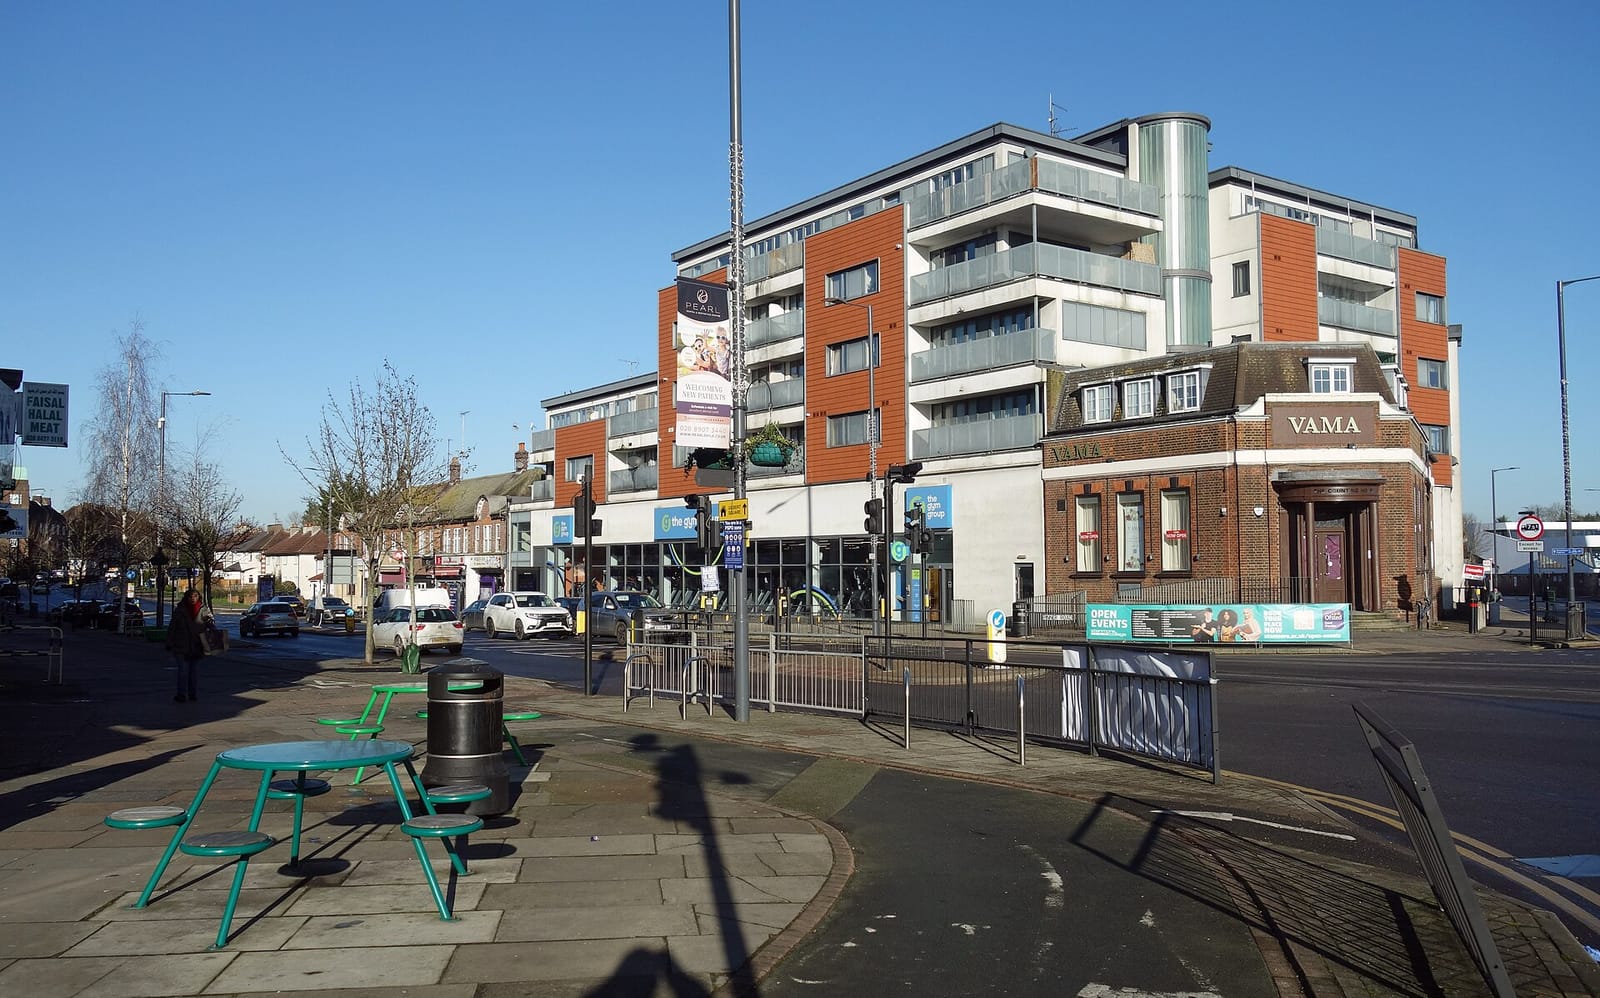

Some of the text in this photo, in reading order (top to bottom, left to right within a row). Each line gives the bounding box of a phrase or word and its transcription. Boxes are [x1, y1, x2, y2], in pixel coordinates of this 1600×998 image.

[686, 302, 720, 314] PEARL
[685, 384, 722, 393] WELCOMING
[698, 392, 726, 400] PATIENTS
[27, 396, 64, 408] FAISAL
[28, 408, 63, 420] HALAL
[31, 422, 60, 433] MEAT
[1287, 416, 1361, 434] VAMA
[1053, 443, 1102, 461] VAMA
[927, 503, 941, 511] gym
[927, 511, 945, 519] group
[672, 516, 682, 527] the
[1091, 610, 1117, 618] OPEN
[1091, 619, 1128, 628] EVENTS
